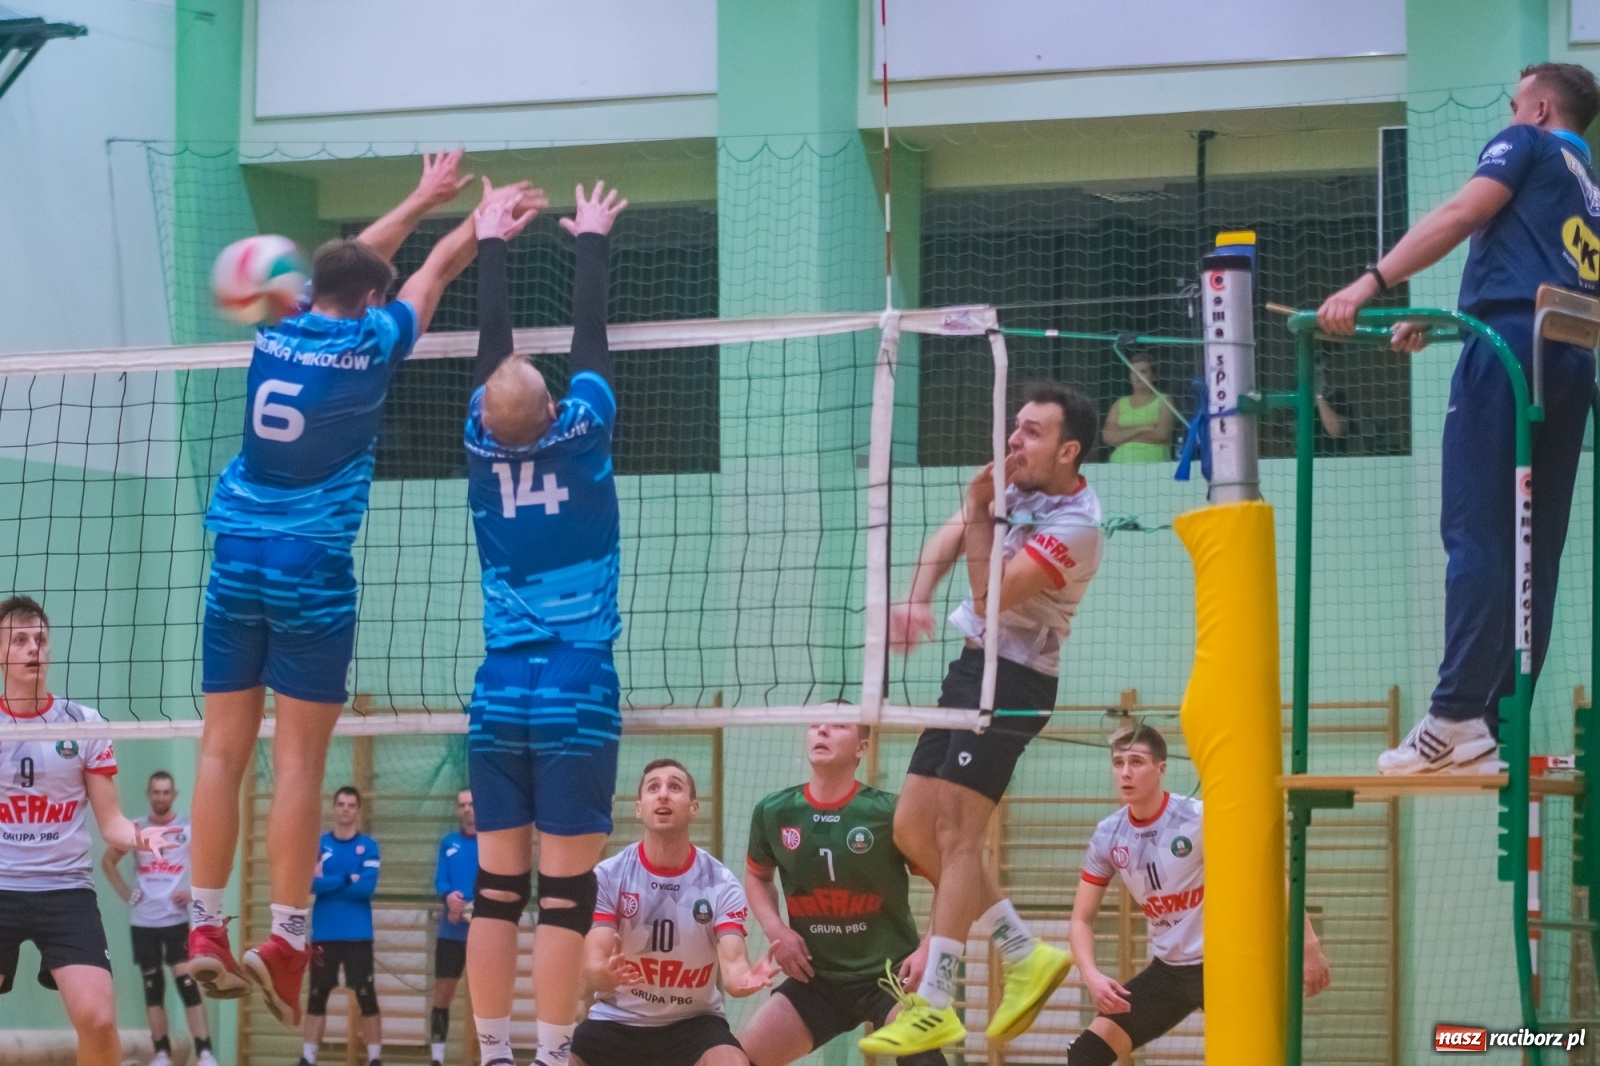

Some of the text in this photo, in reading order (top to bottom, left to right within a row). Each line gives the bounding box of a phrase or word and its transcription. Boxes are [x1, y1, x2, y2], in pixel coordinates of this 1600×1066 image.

[252, 378, 305, 443] 6
[491, 460, 570, 519] 14
[20, 756, 34, 788] 9
[2, 831, 60, 842] GRUPA PBG
[819, 847, 836, 882] 7
[1146, 861, 1162, 891] 11
[651, 918, 675, 954] 10
[810, 922, 868, 934] GRUPA PBG
[631, 988, 693, 1005] GRUPA PBG
